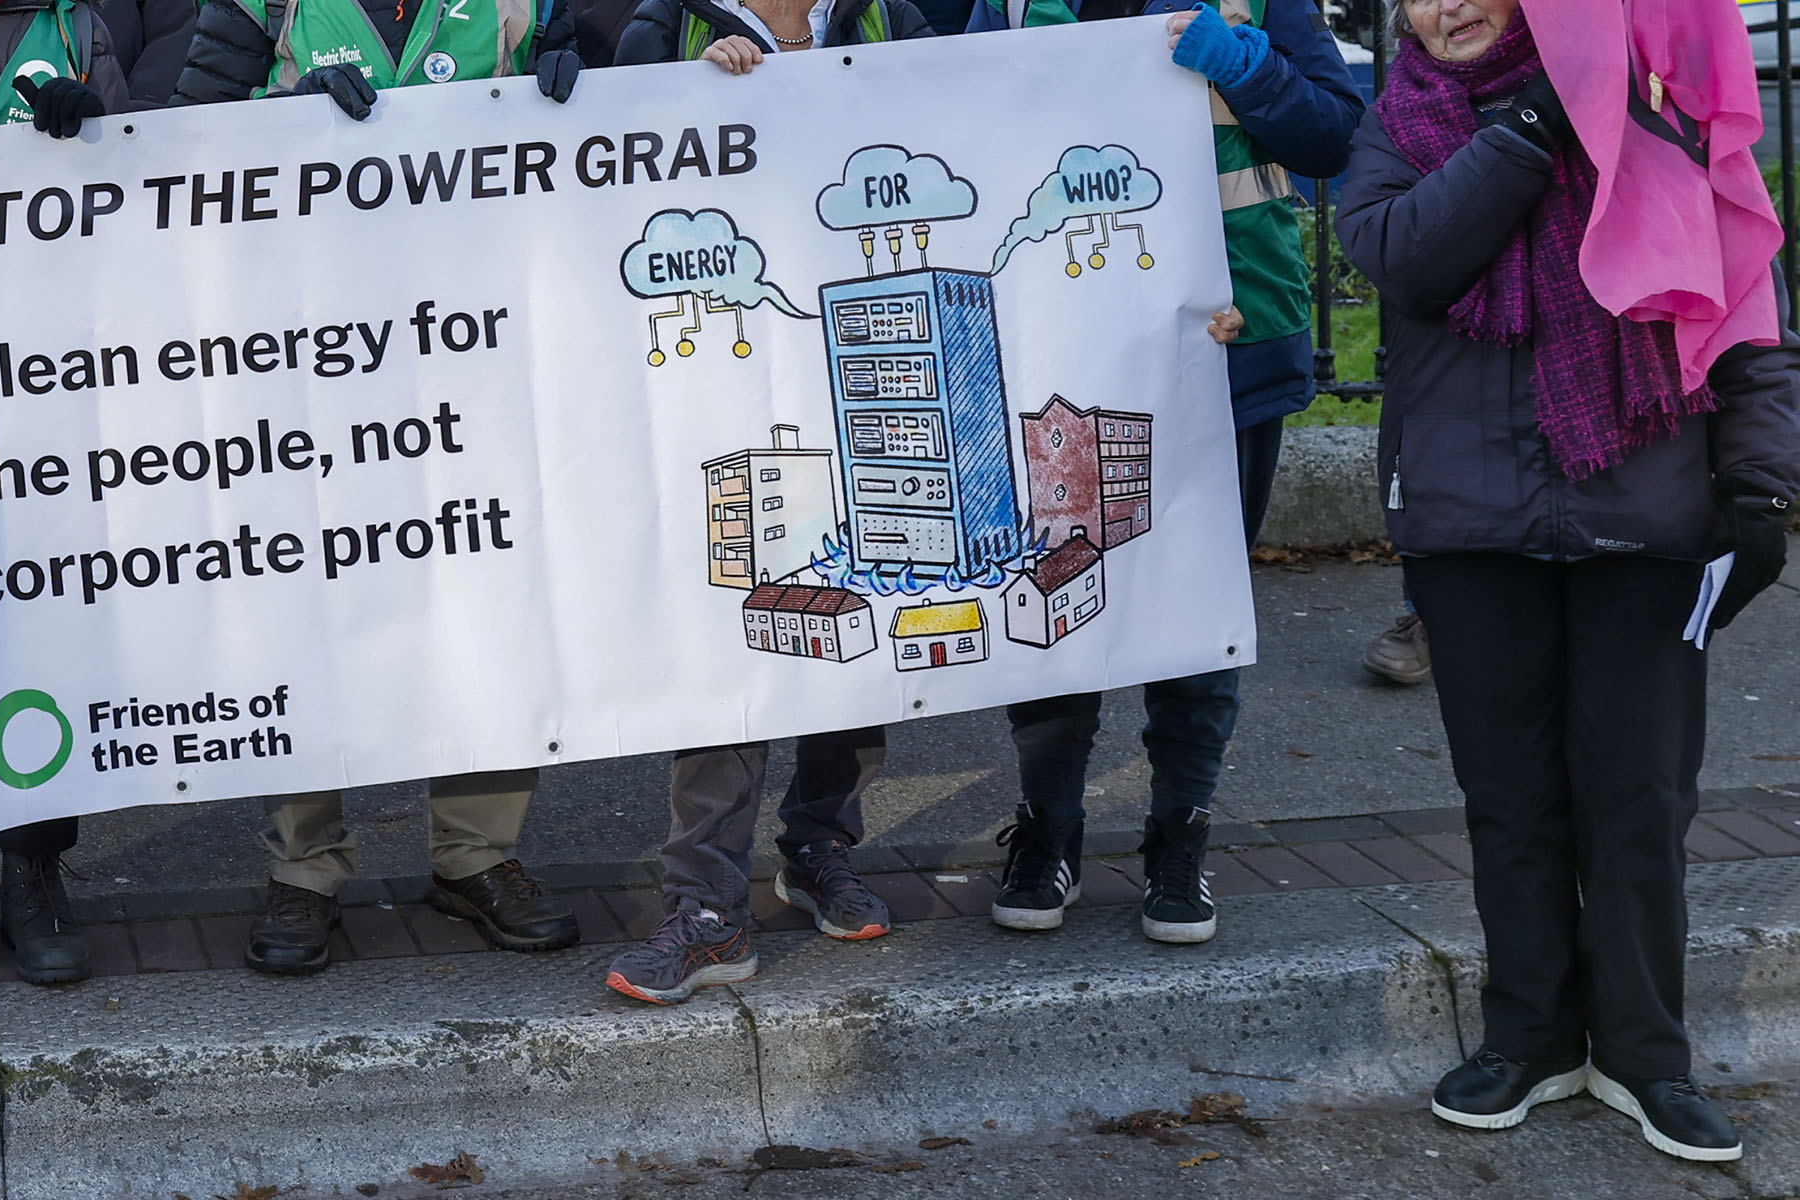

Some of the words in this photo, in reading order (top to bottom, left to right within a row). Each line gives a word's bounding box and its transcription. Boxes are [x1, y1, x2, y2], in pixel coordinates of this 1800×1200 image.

[311, 47, 340, 67] Electric
[339, 43, 362, 65] Picnic
[8, 106, 35, 121] Frien
[143, 166, 279, 230] THE
[298, 141, 557, 217] POWER
[576, 123, 758, 189] GRAB
[864, 172, 912, 209] FOR
[1061, 165, 1132, 204] WHO?
[648, 244, 737, 284] ENERGY
[157, 319, 393, 381] energy
[409, 300, 508, 356] for
[87, 418, 333, 502] people,
[351, 402, 464, 464] not
[322, 498, 513, 580] profit
[88, 692, 240, 733] Friends
[248, 684, 289, 719] of
[91, 738, 159, 773] the
[172, 726, 293, 765] Earth
